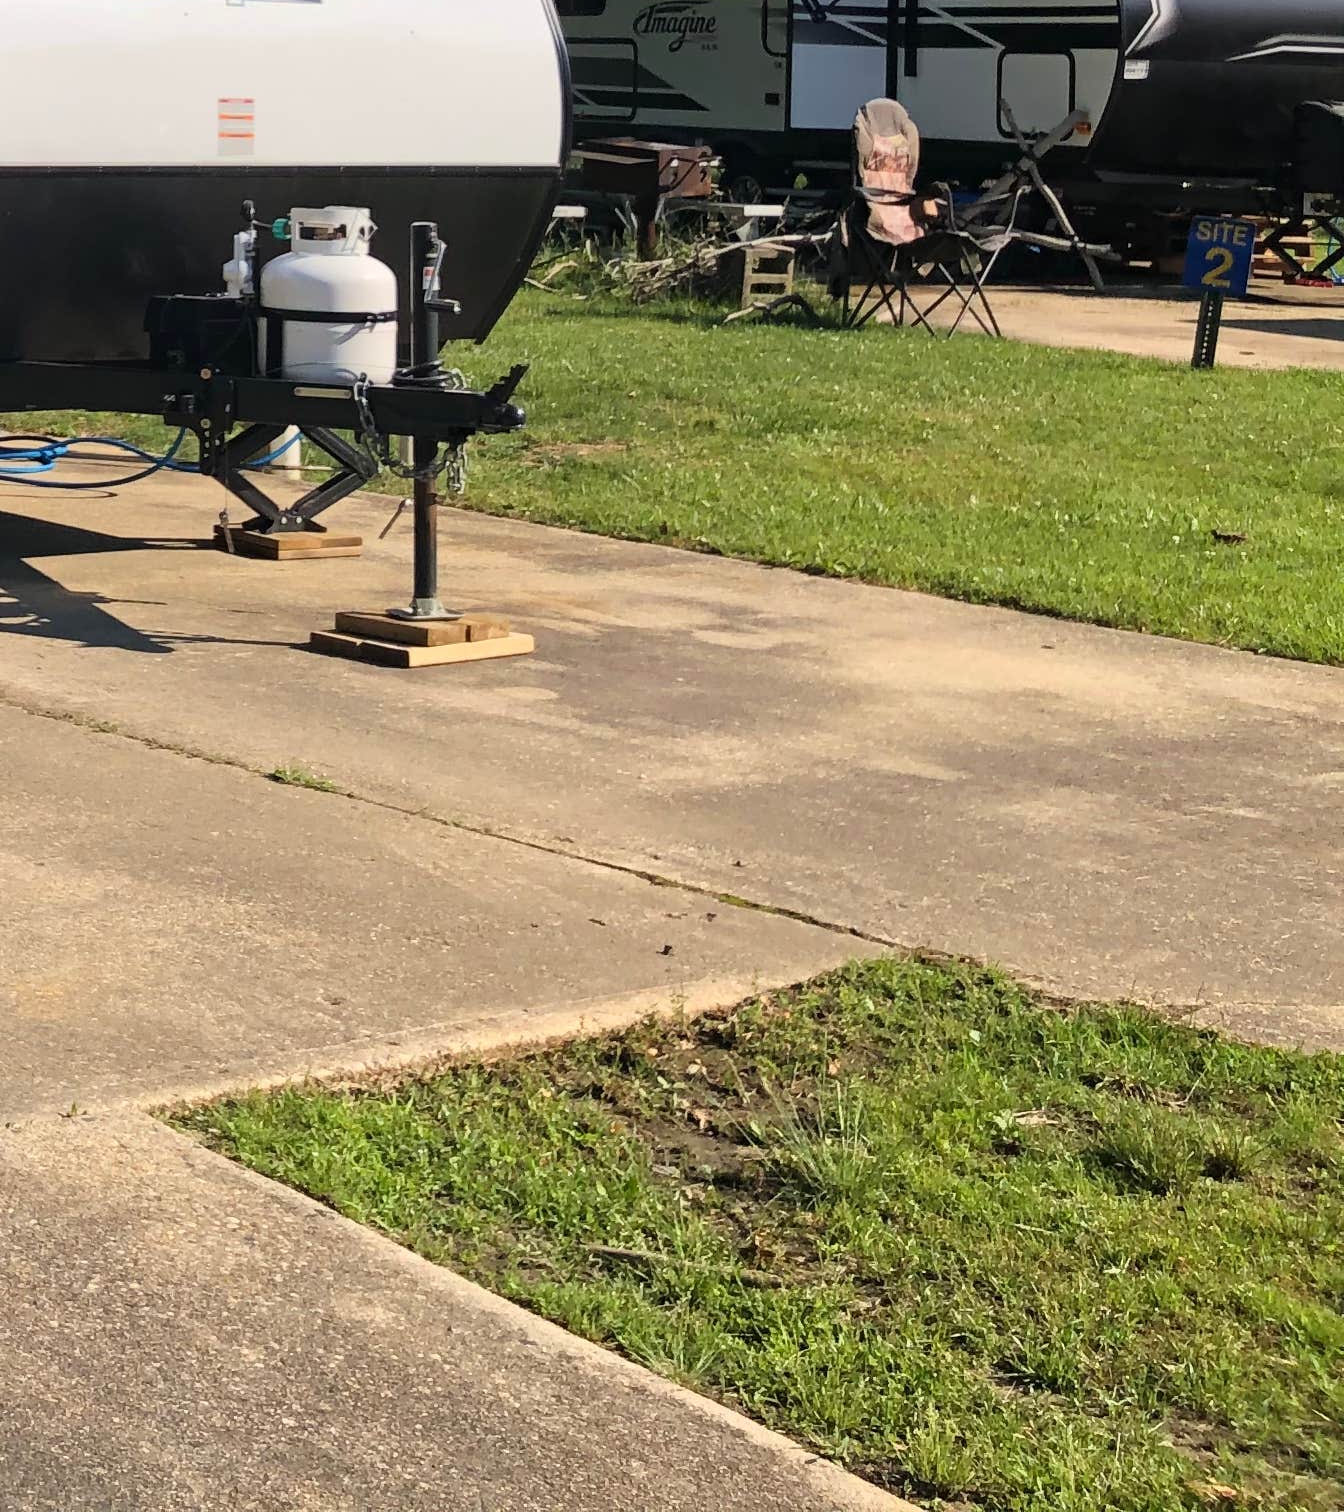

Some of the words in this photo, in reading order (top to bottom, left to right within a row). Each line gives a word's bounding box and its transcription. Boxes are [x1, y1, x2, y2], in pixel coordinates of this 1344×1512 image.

[633, 1, 718, 52] Imagine
[1196, 220, 1248, 247] SITE
[1201, 247, 1235, 289] 2
